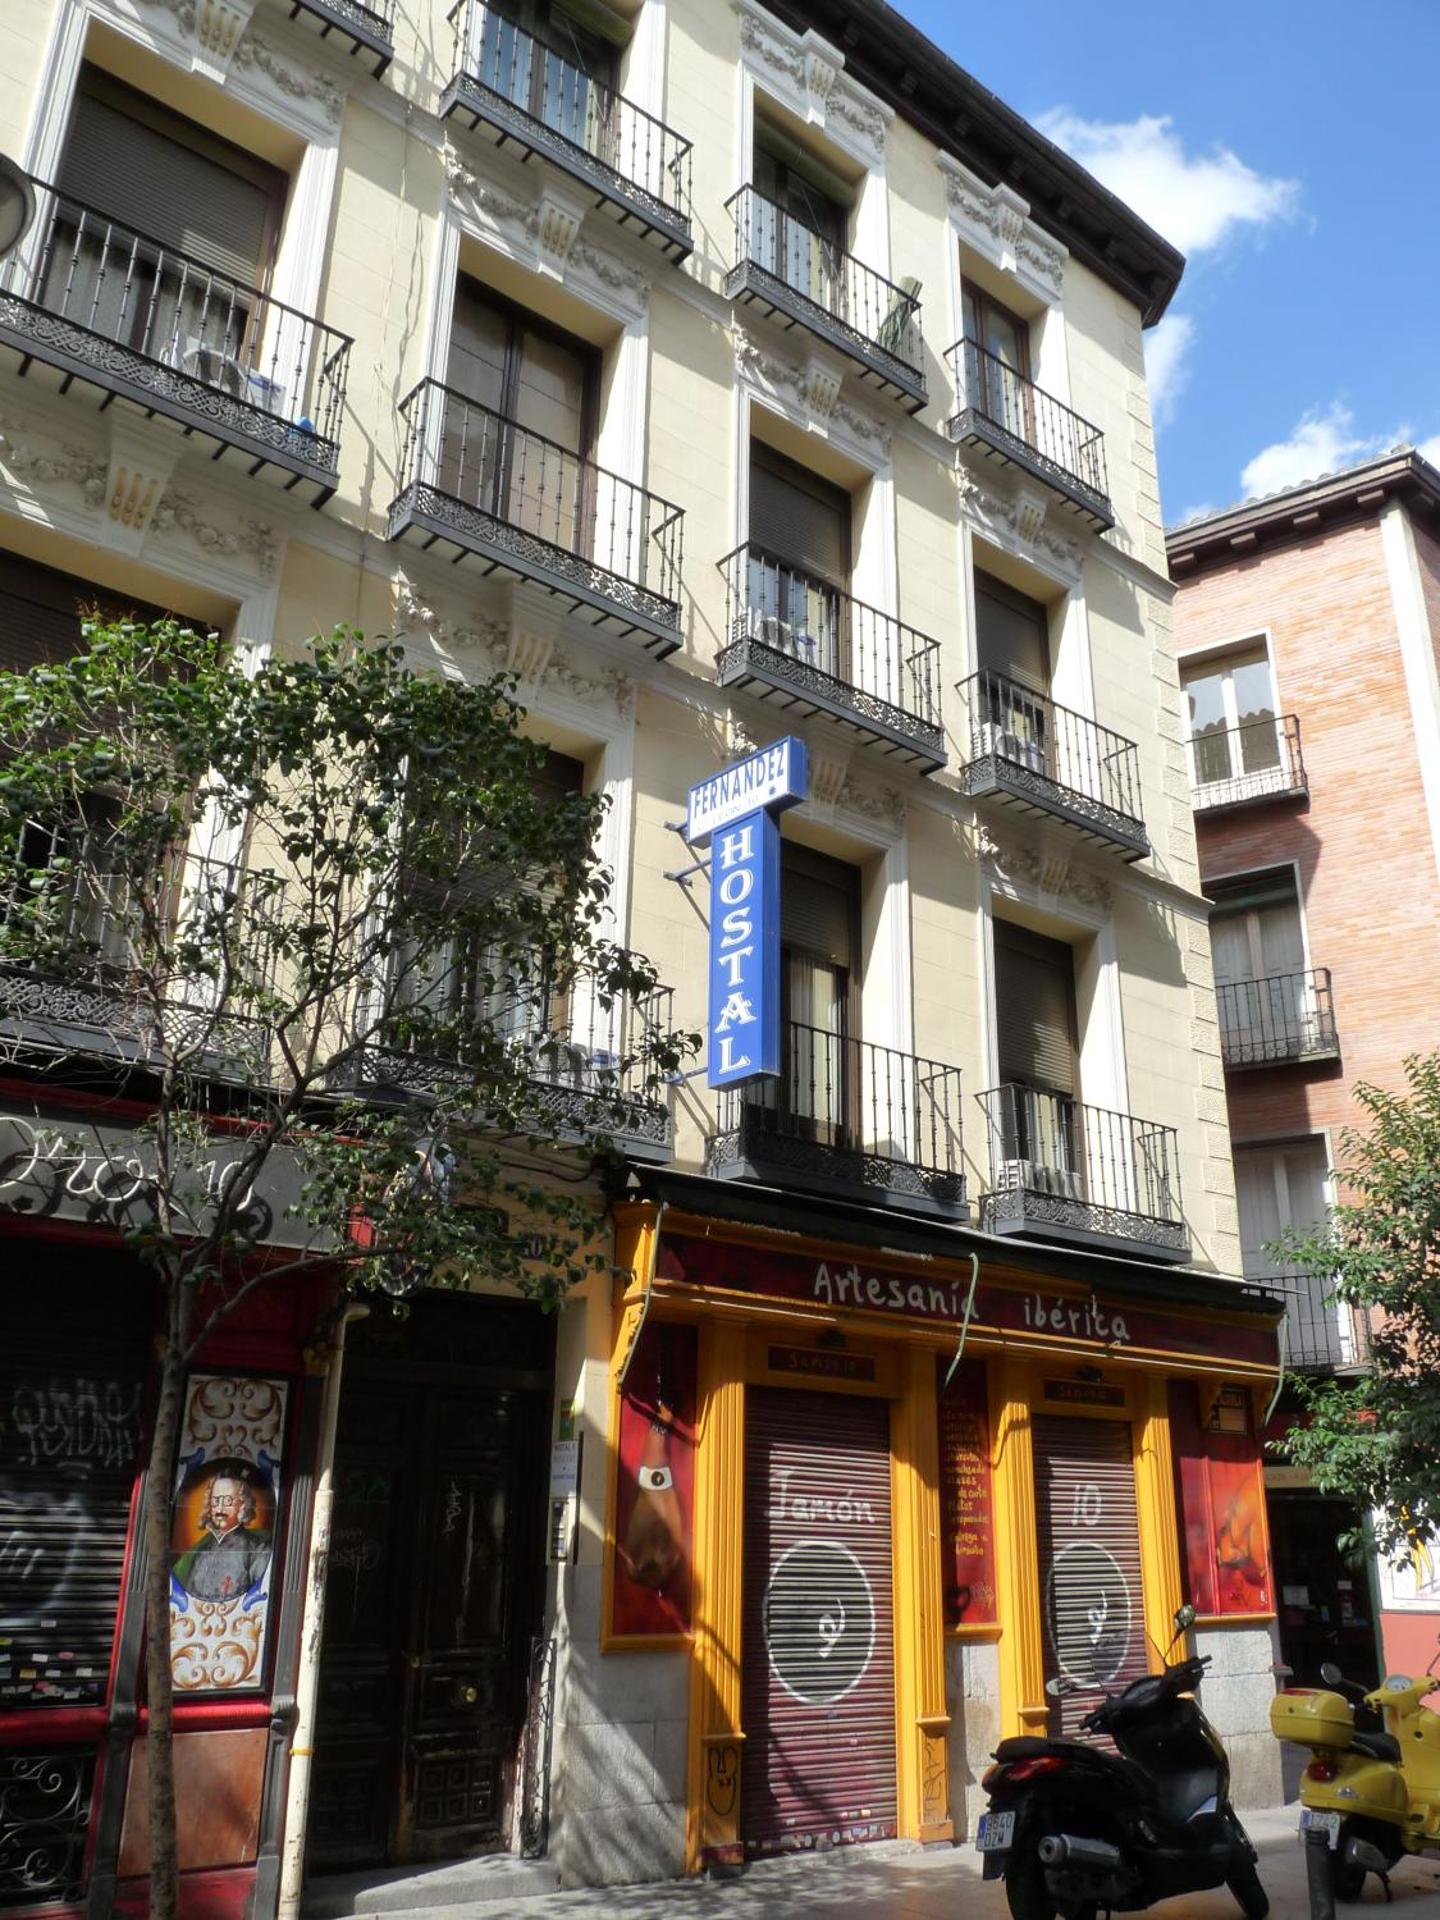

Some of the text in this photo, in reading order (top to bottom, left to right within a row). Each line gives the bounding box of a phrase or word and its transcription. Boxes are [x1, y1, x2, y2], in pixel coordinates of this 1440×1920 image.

[693, 746, 785, 818] FERNANDEZ
[715, 824, 758, 1075] HOSTAL
[814, 1261, 979, 1319] Artesanía
[765, 1468, 1102, 1526] Jamón 10
